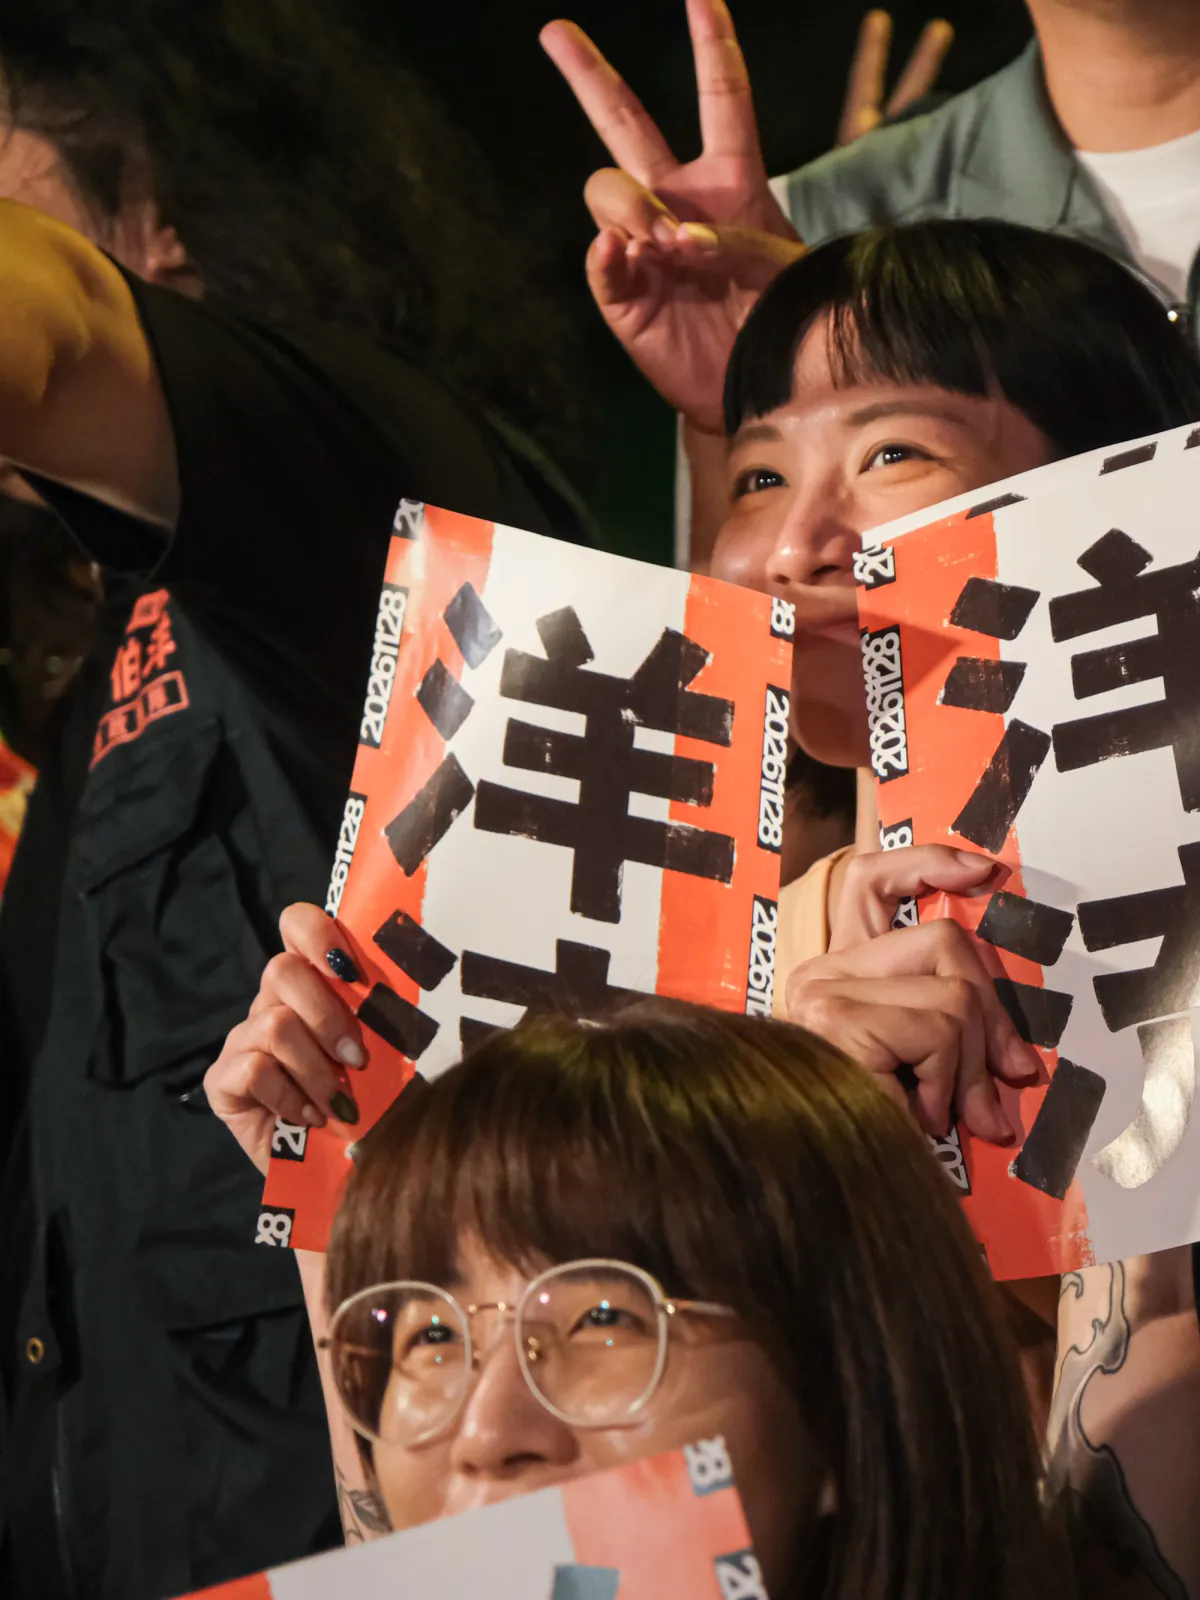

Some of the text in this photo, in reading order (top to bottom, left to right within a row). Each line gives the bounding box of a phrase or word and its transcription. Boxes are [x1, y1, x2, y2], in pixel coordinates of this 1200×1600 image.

[360, 589, 407, 744] 20261128
[861, 632, 908, 776] 20261128
[758, 689, 790, 847] 20261128
